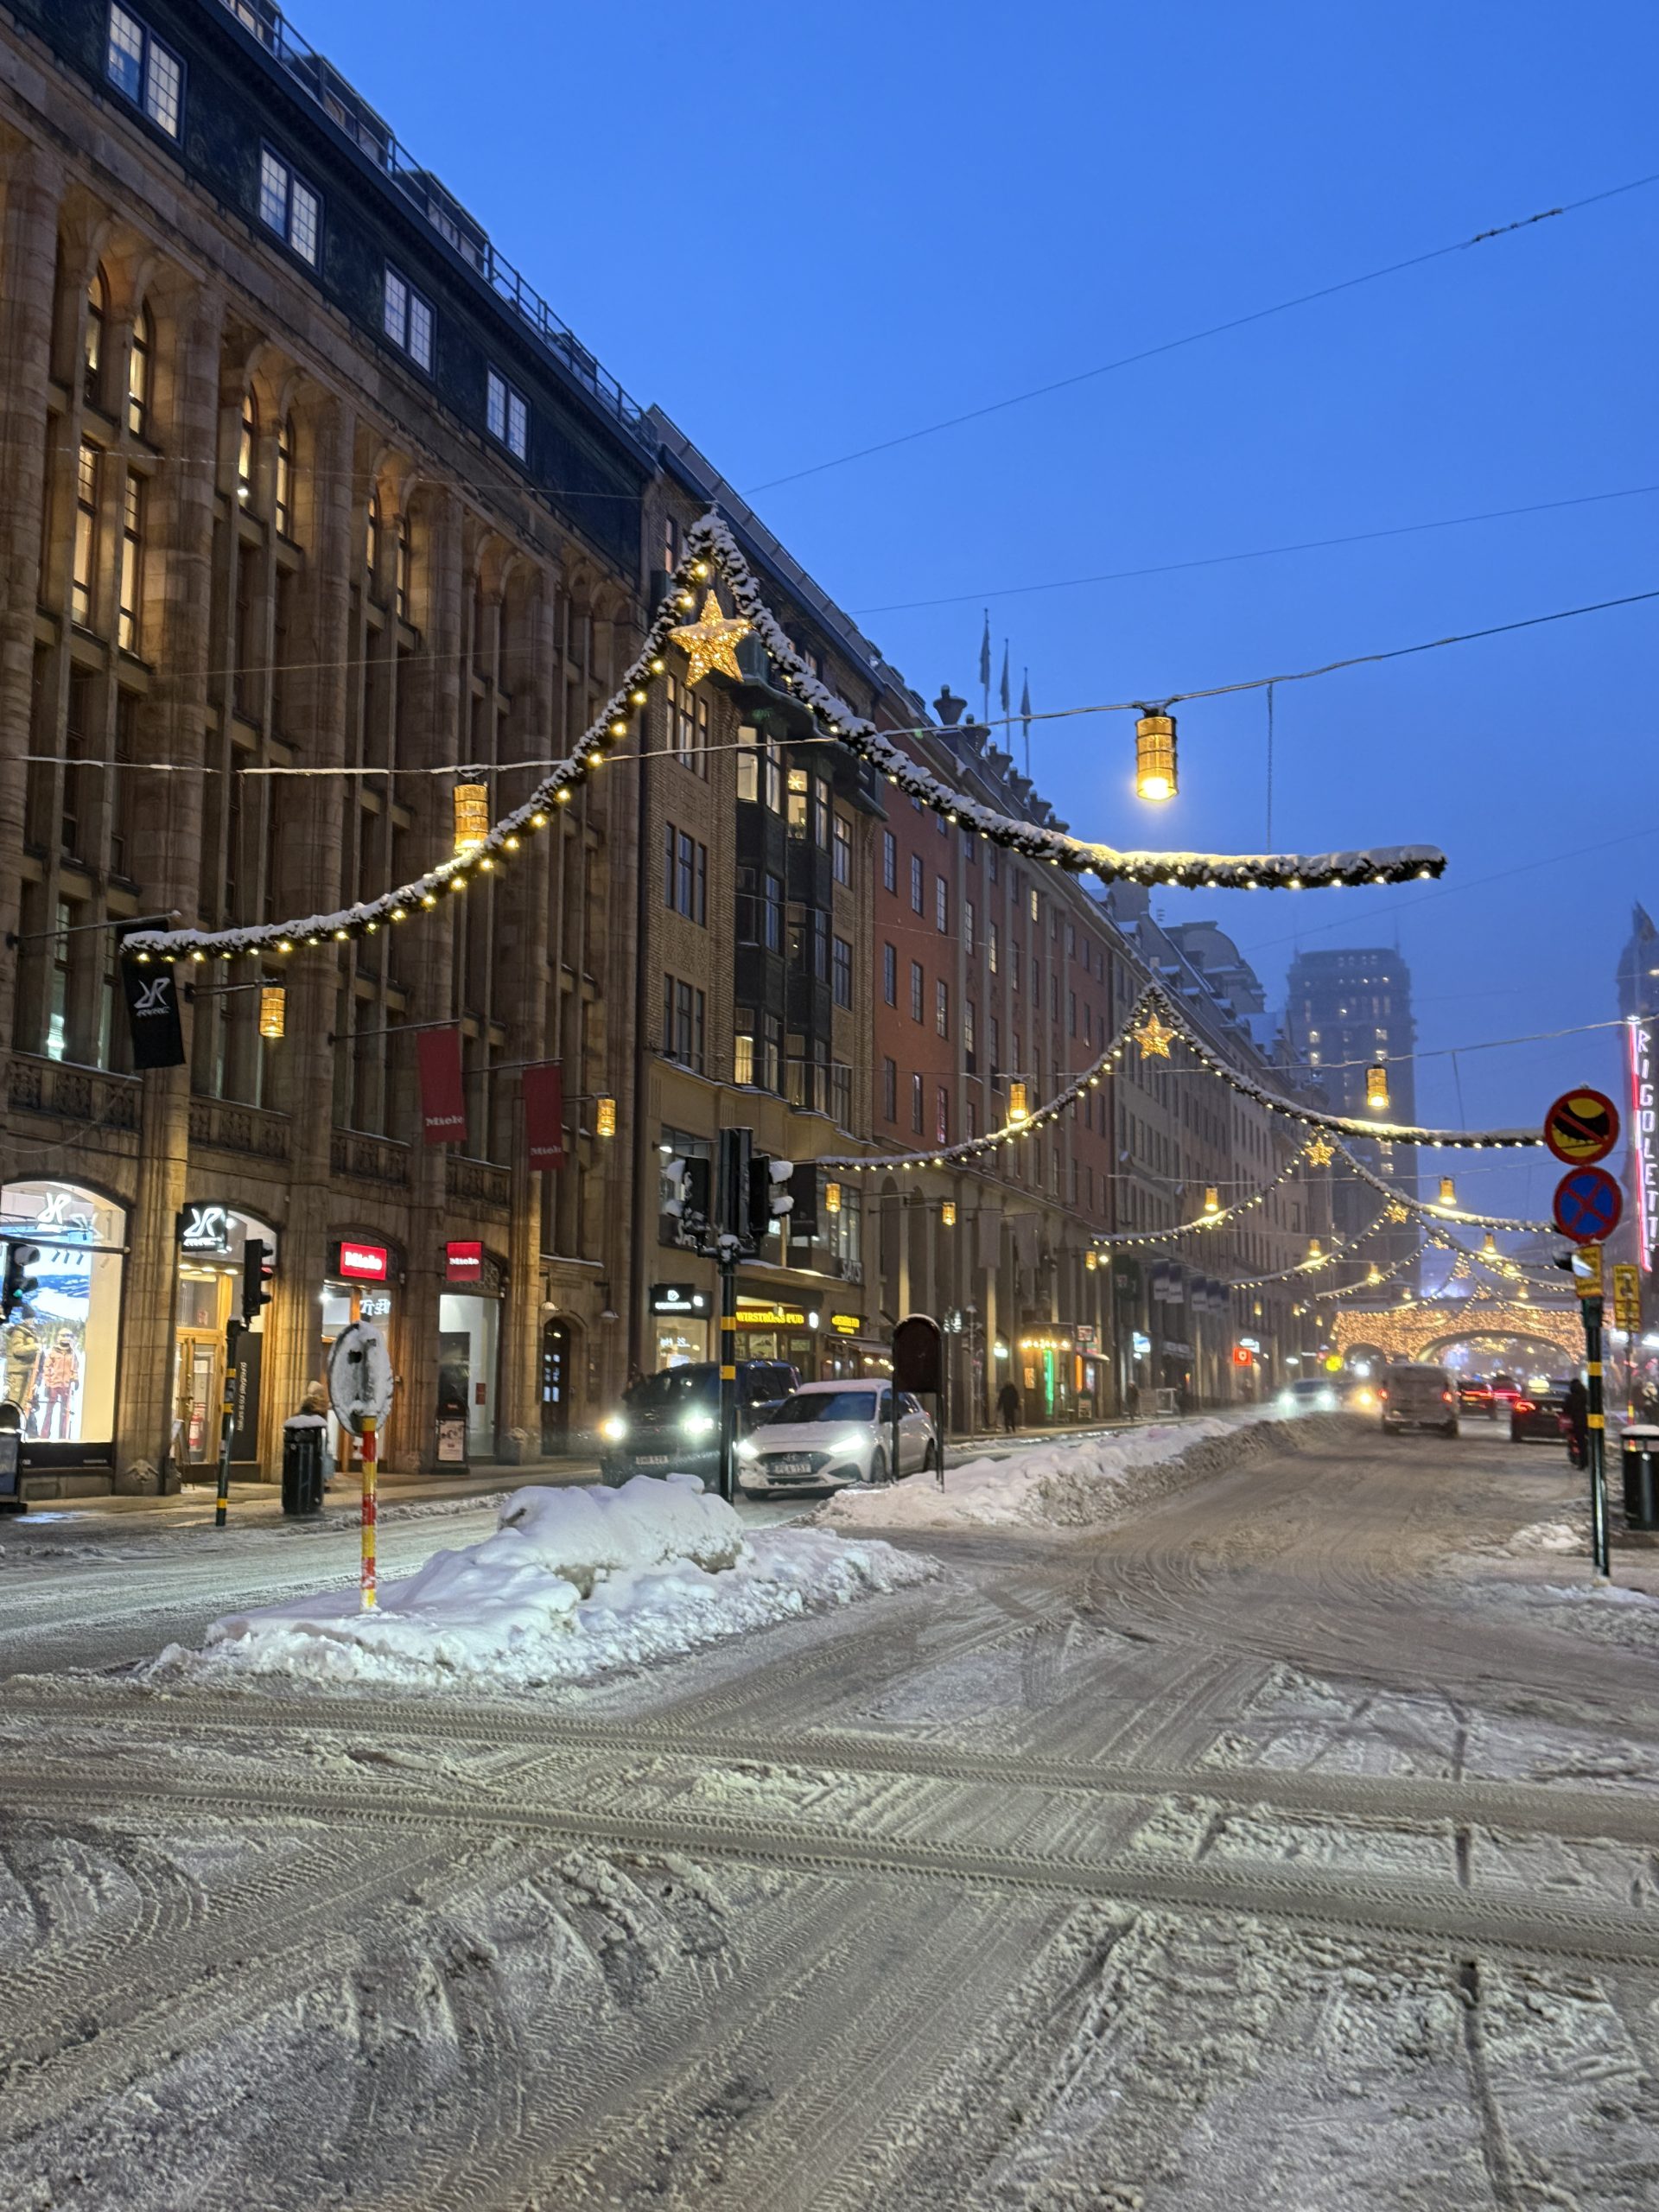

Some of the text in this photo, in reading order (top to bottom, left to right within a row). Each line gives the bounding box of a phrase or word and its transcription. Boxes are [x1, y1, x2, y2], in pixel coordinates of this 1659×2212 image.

[344, 1251, 383, 1271] Miele
[448, 1257, 480, 1266] Miele
[785, 1313, 804, 1325] PUB
